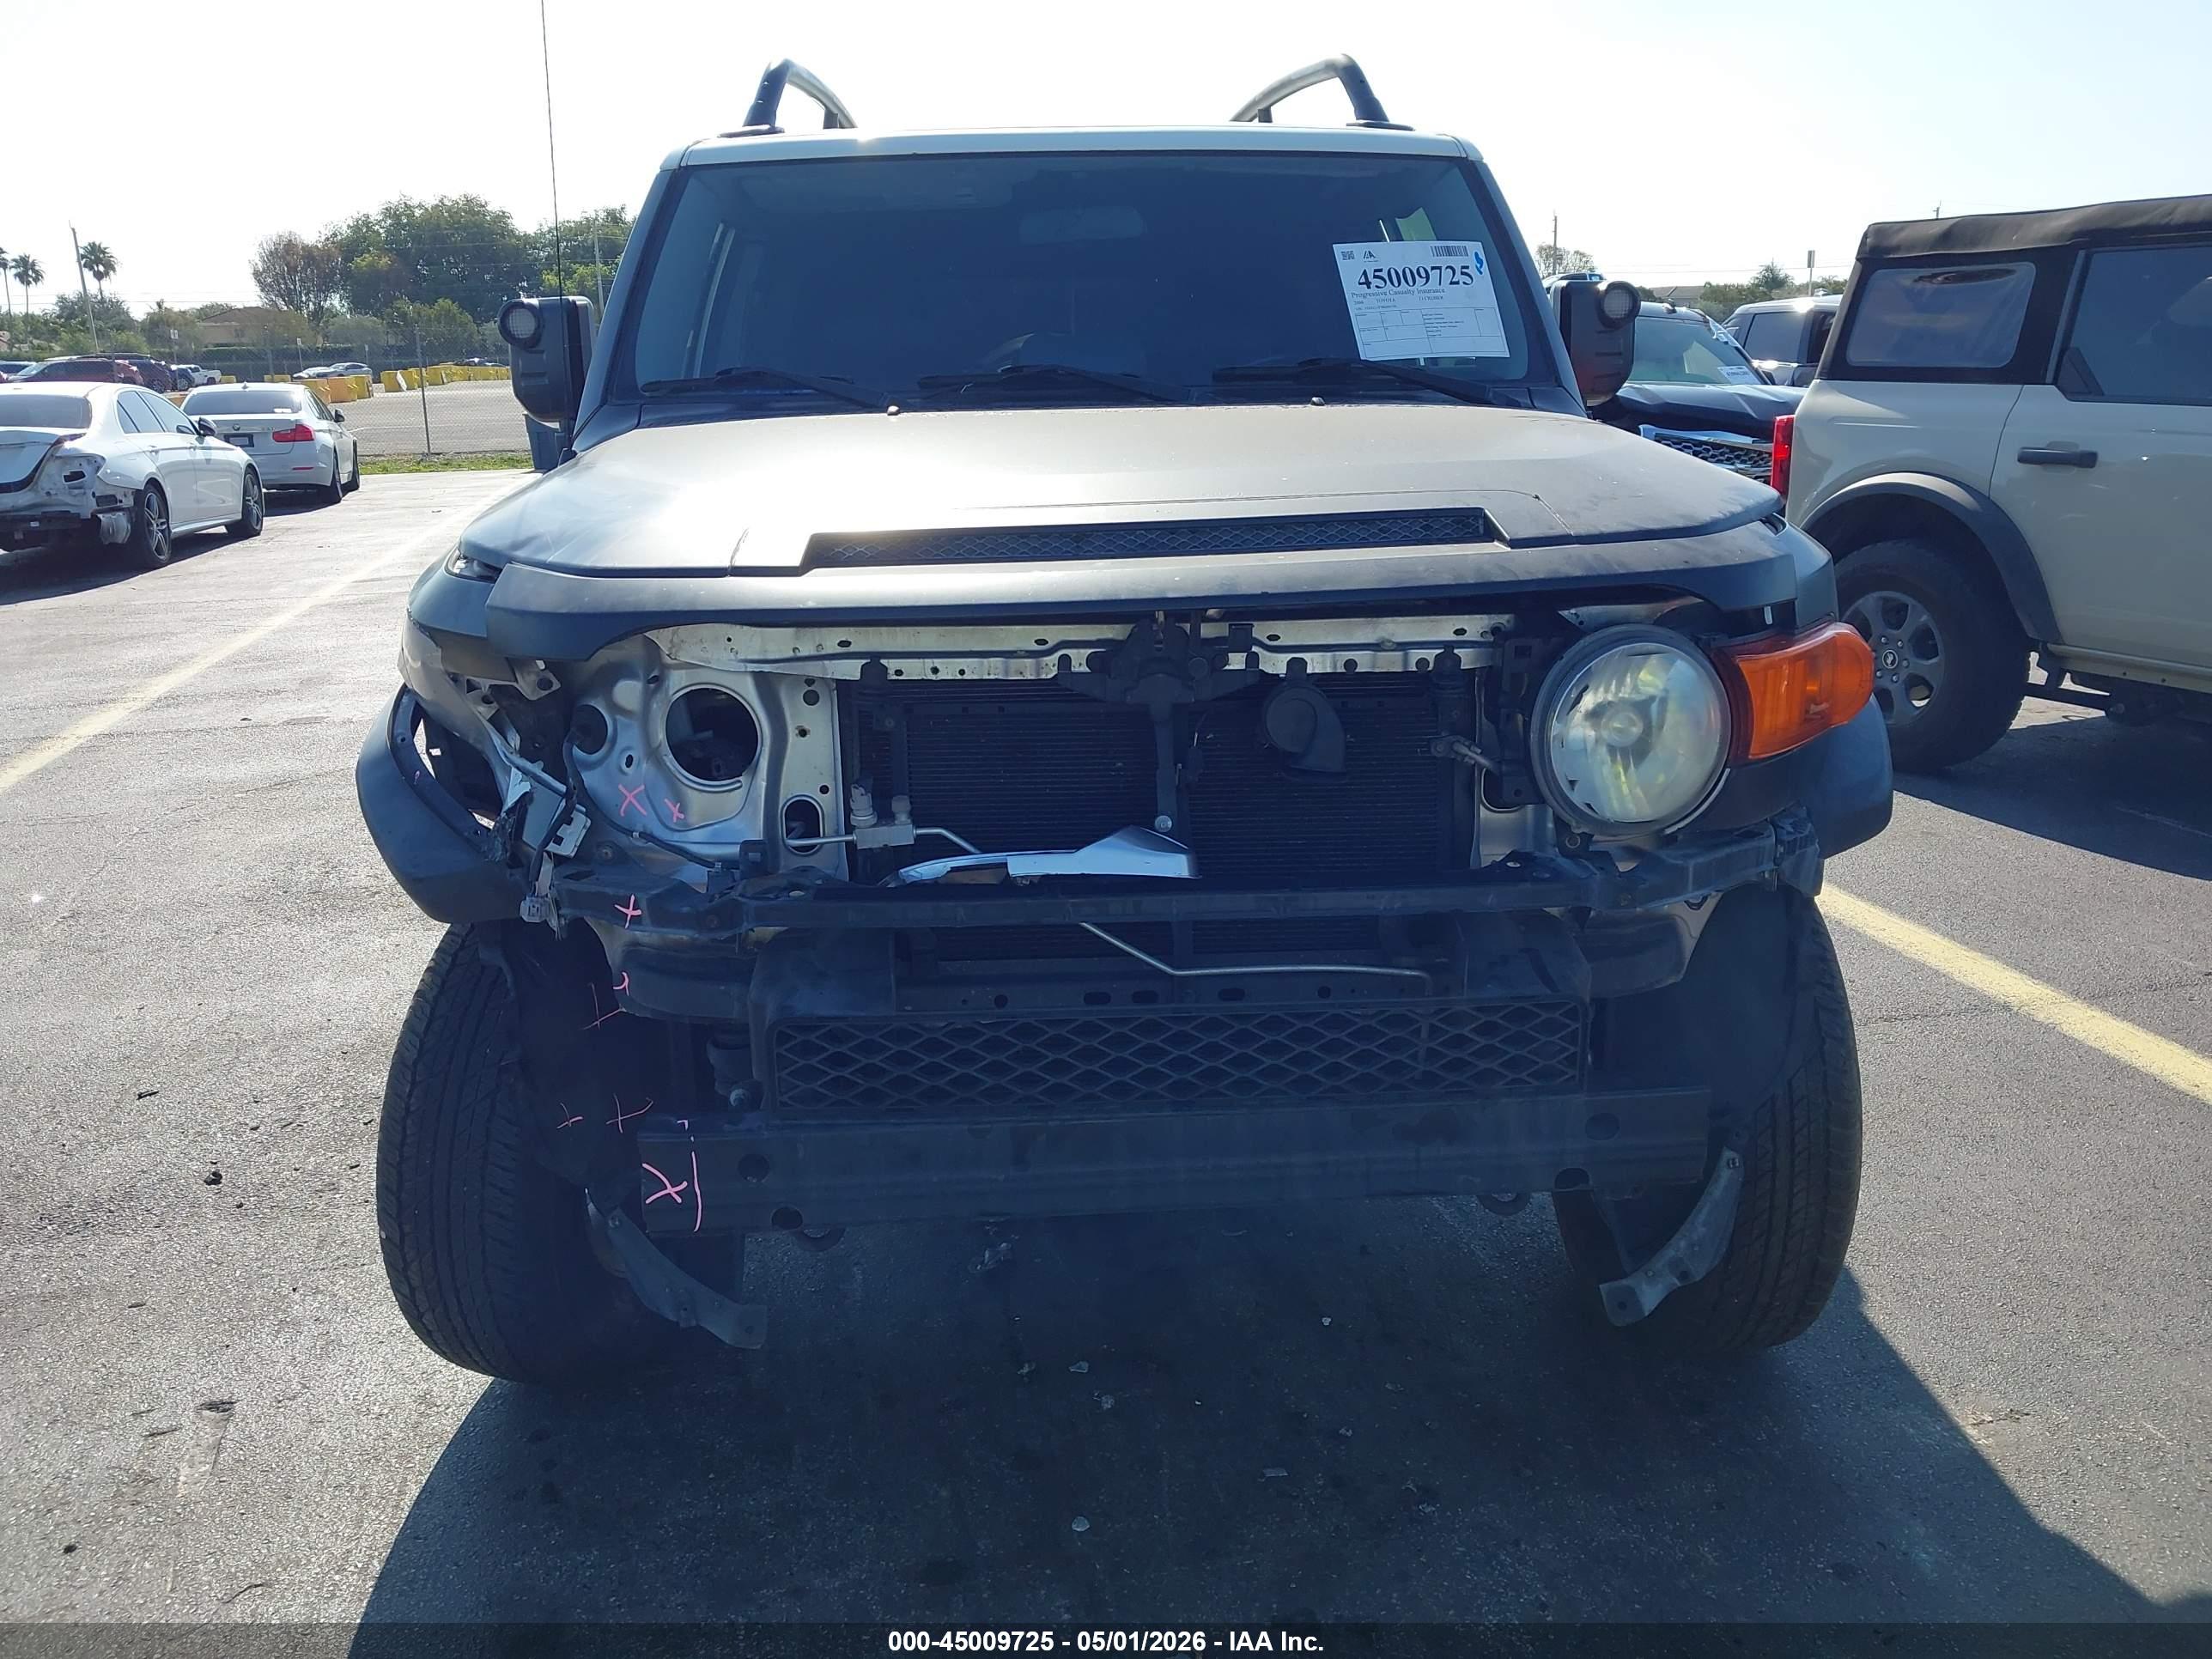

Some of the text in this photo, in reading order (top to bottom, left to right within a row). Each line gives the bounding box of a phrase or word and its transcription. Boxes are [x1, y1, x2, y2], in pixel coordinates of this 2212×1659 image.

[1358, 265, 1474, 289] 45009725
[1351, 289, 1388, 299] Progressive
[1389, 288, 1415, 296] Casualty
